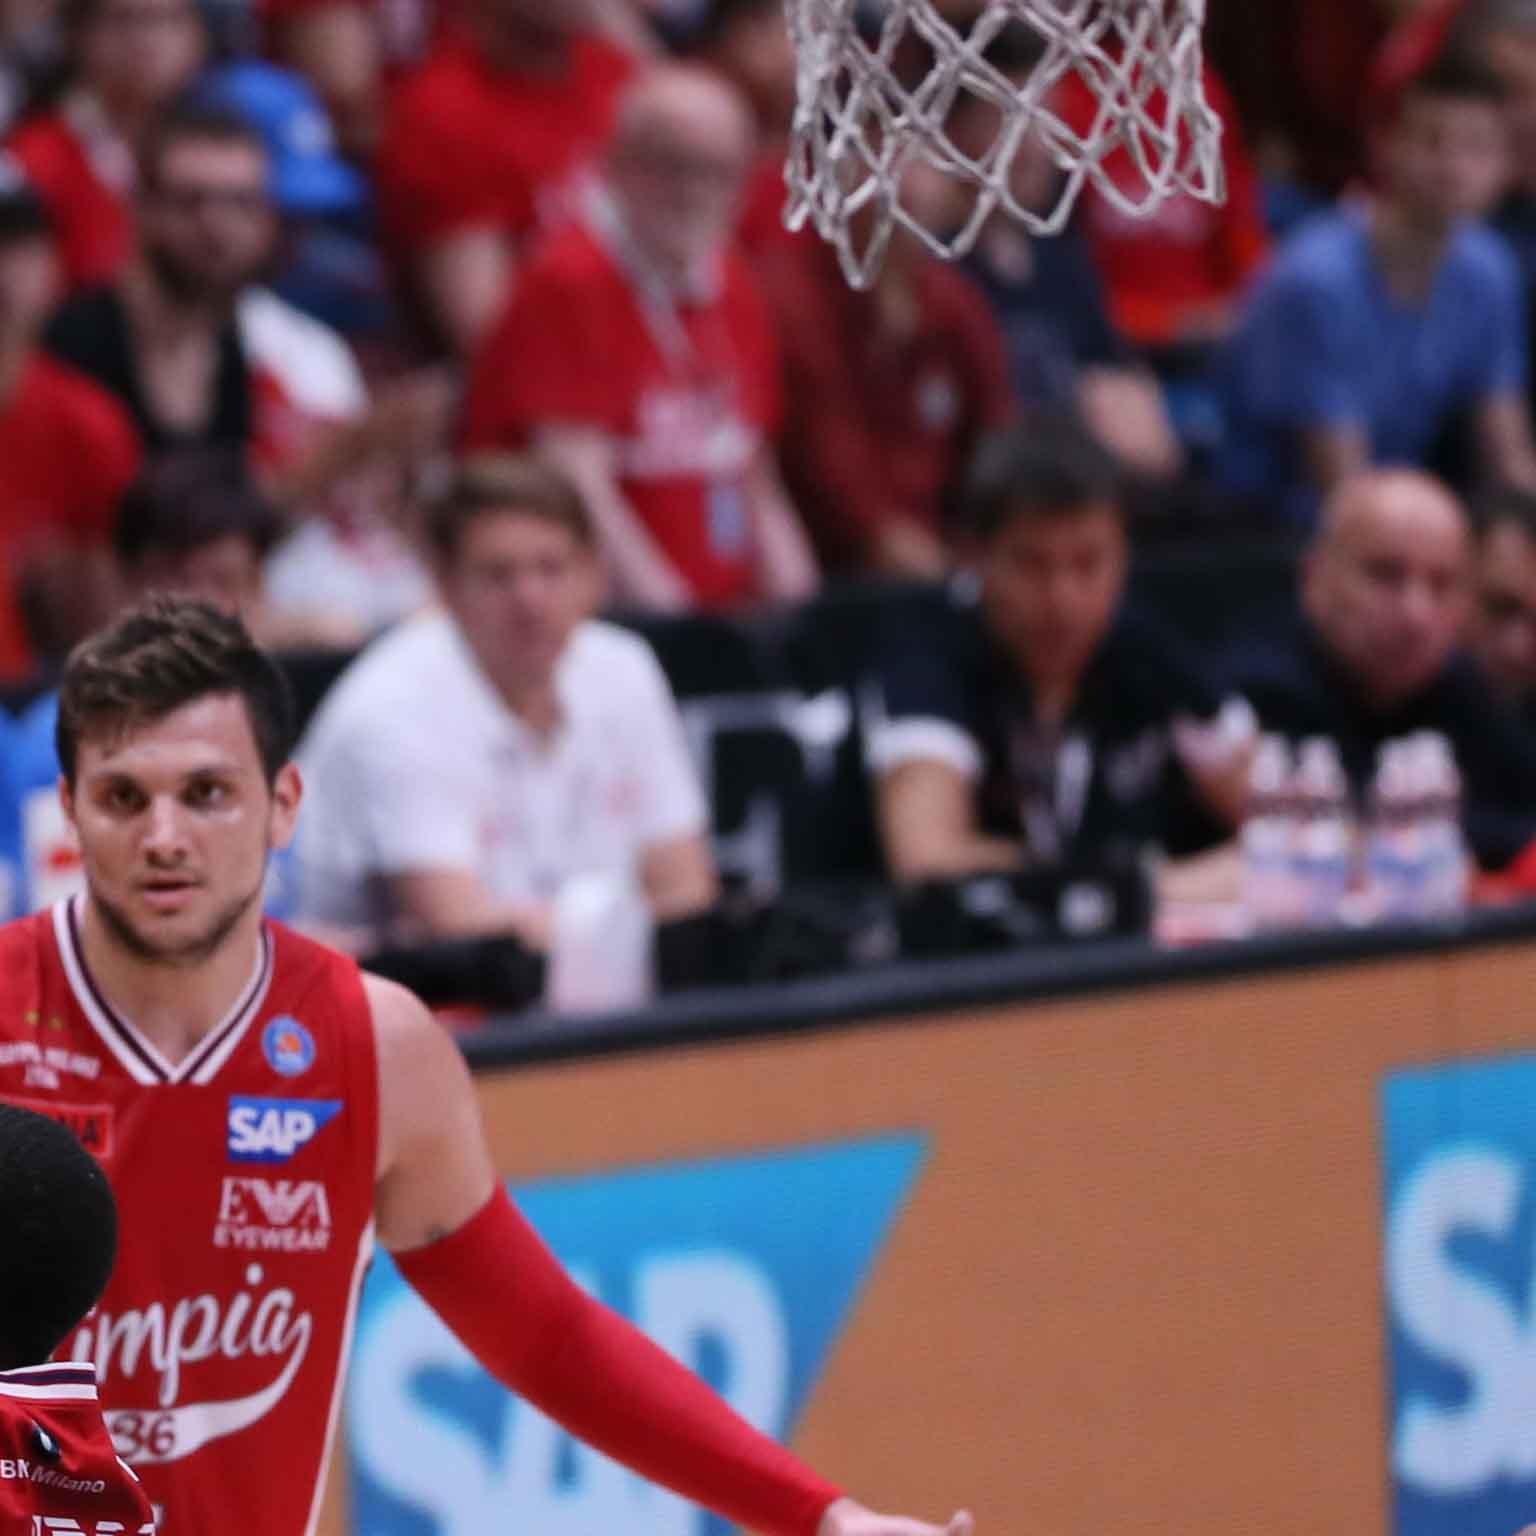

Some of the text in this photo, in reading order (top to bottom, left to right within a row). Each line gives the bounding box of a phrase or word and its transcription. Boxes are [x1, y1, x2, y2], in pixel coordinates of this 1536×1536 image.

[228, 1106, 316, 1155] SAP
[213, 1222, 330, 1250] EYEWEAR
[31, 1465, 106, 1493] Milano
